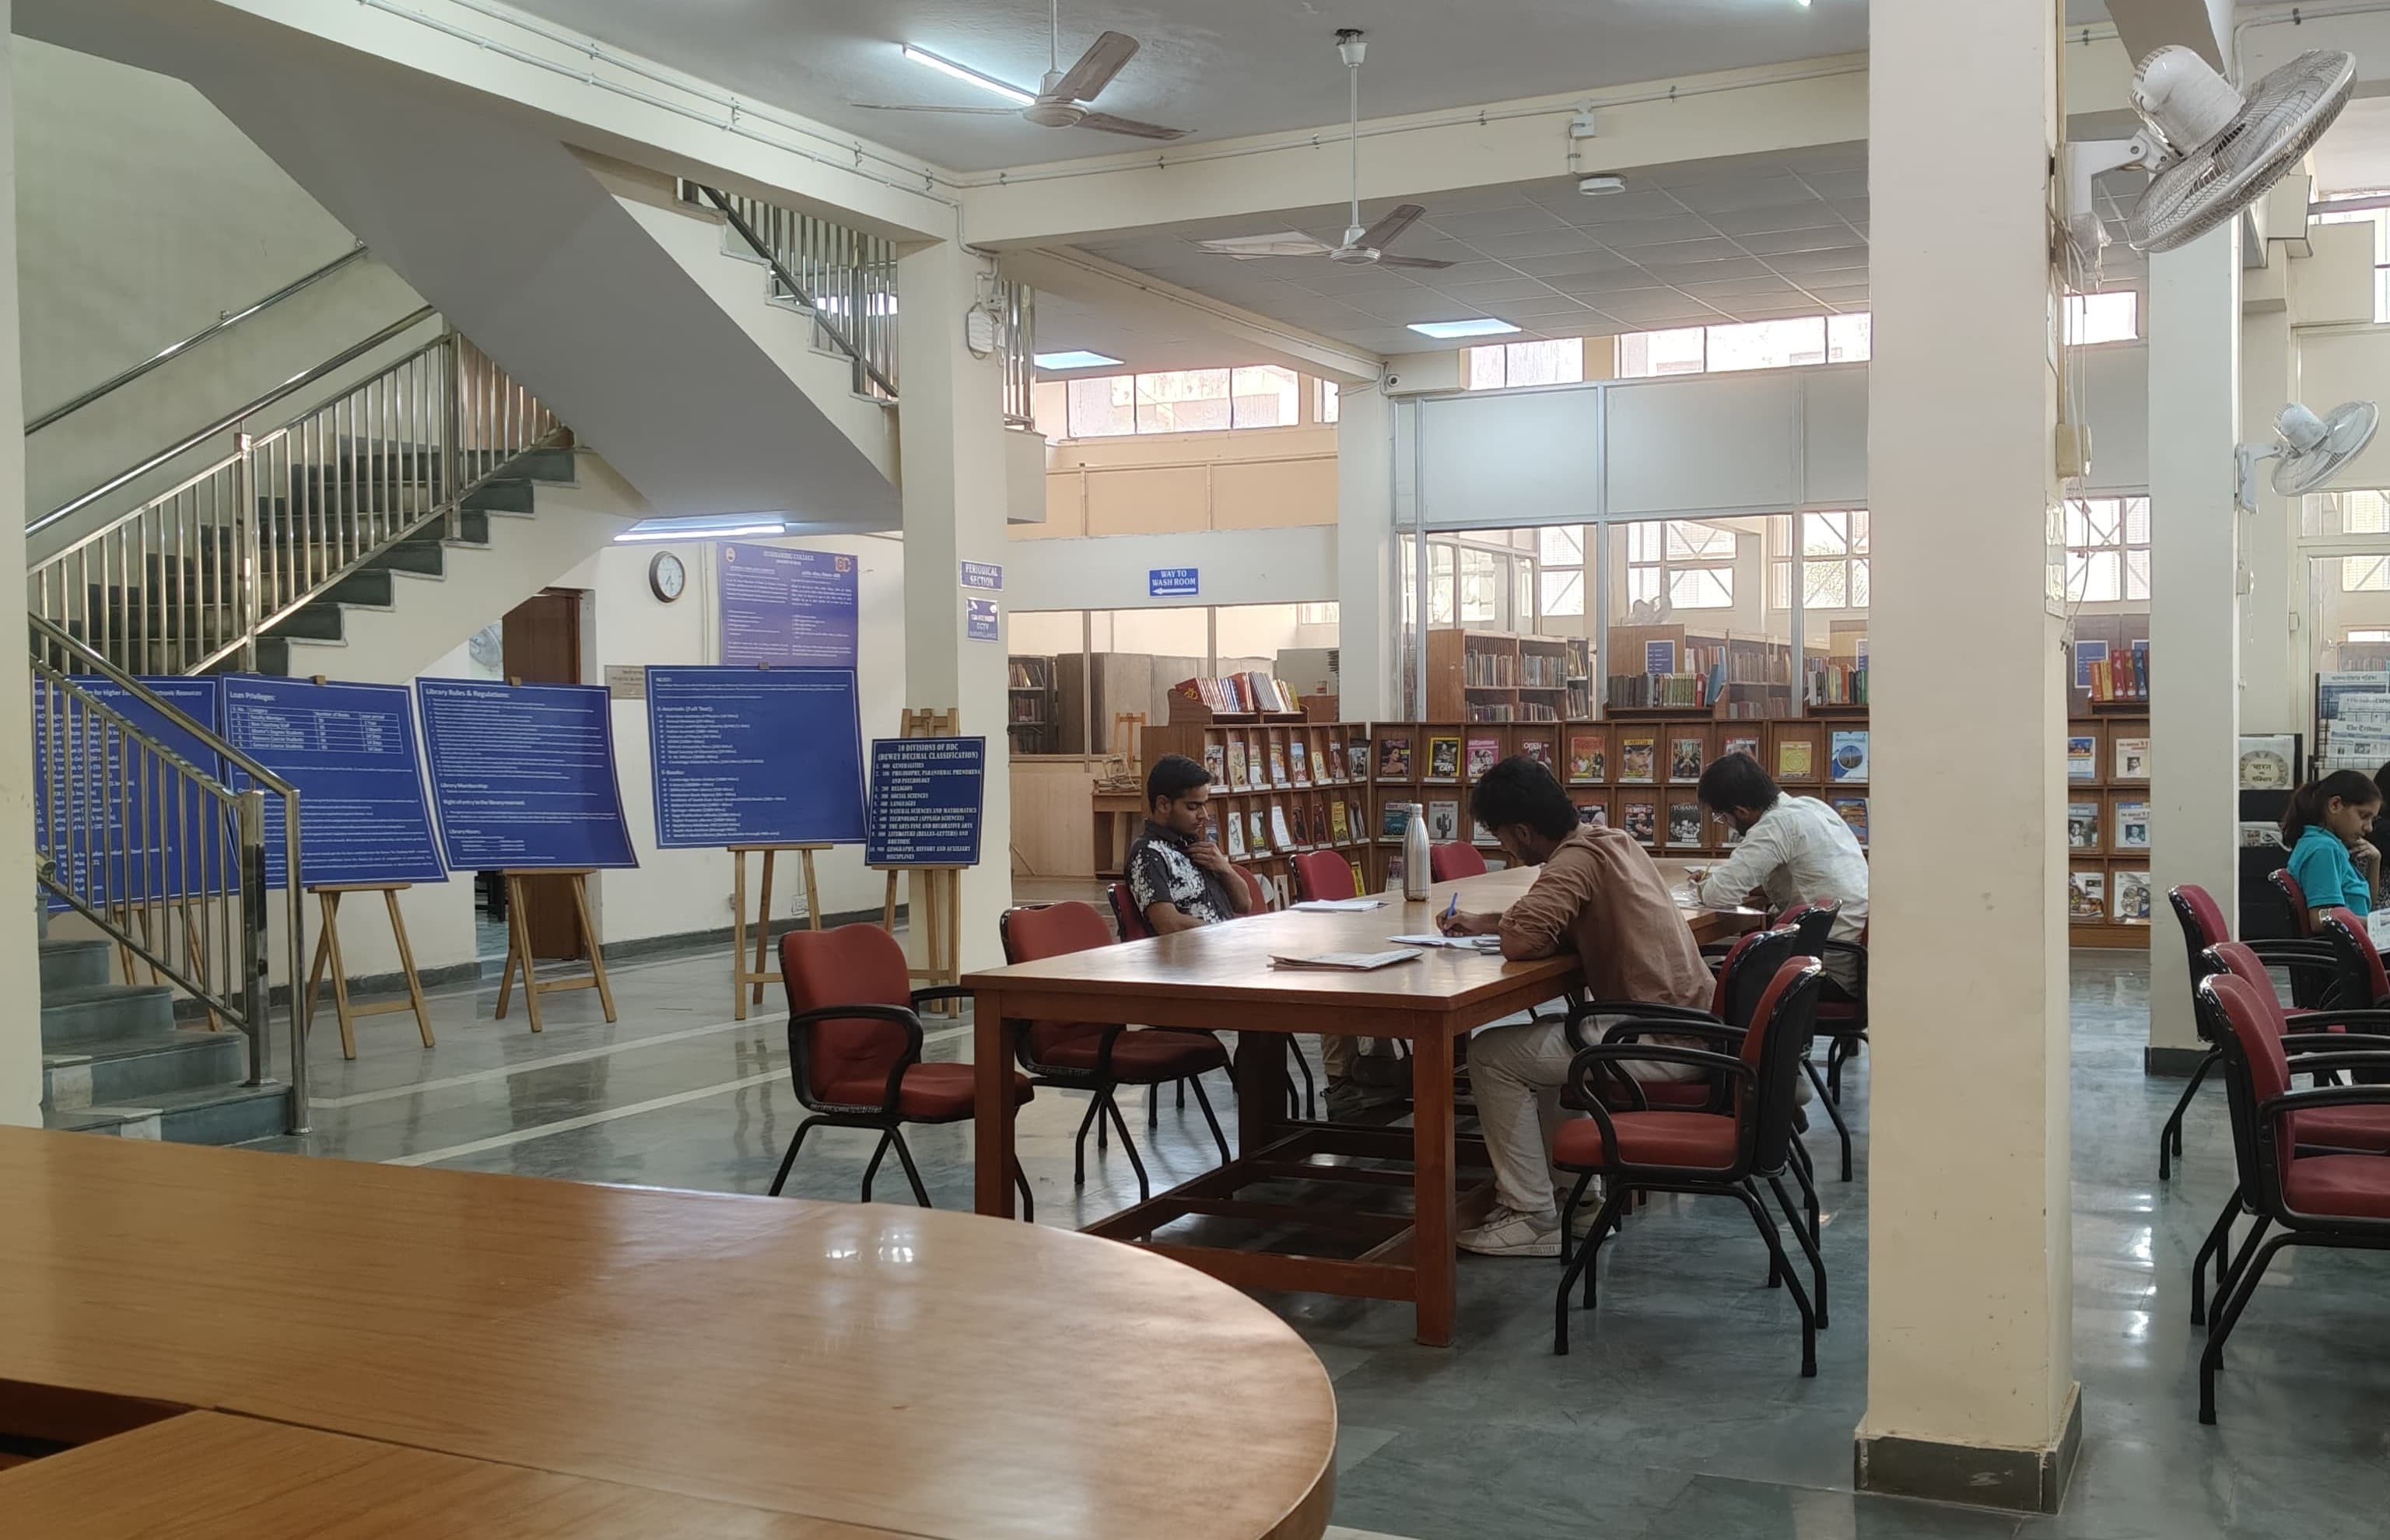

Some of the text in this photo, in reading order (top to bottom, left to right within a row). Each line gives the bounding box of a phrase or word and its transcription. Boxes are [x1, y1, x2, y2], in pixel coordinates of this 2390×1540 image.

[965, 563, 998, 576] PERIODICAL
[970, 576, 994, 586] SECTION
[1174, 577, 1196, 586] ROOM
[2358, 724, 2382, 733] Tribune
[928, 751, 979, 760] CLASSIFICATION)
